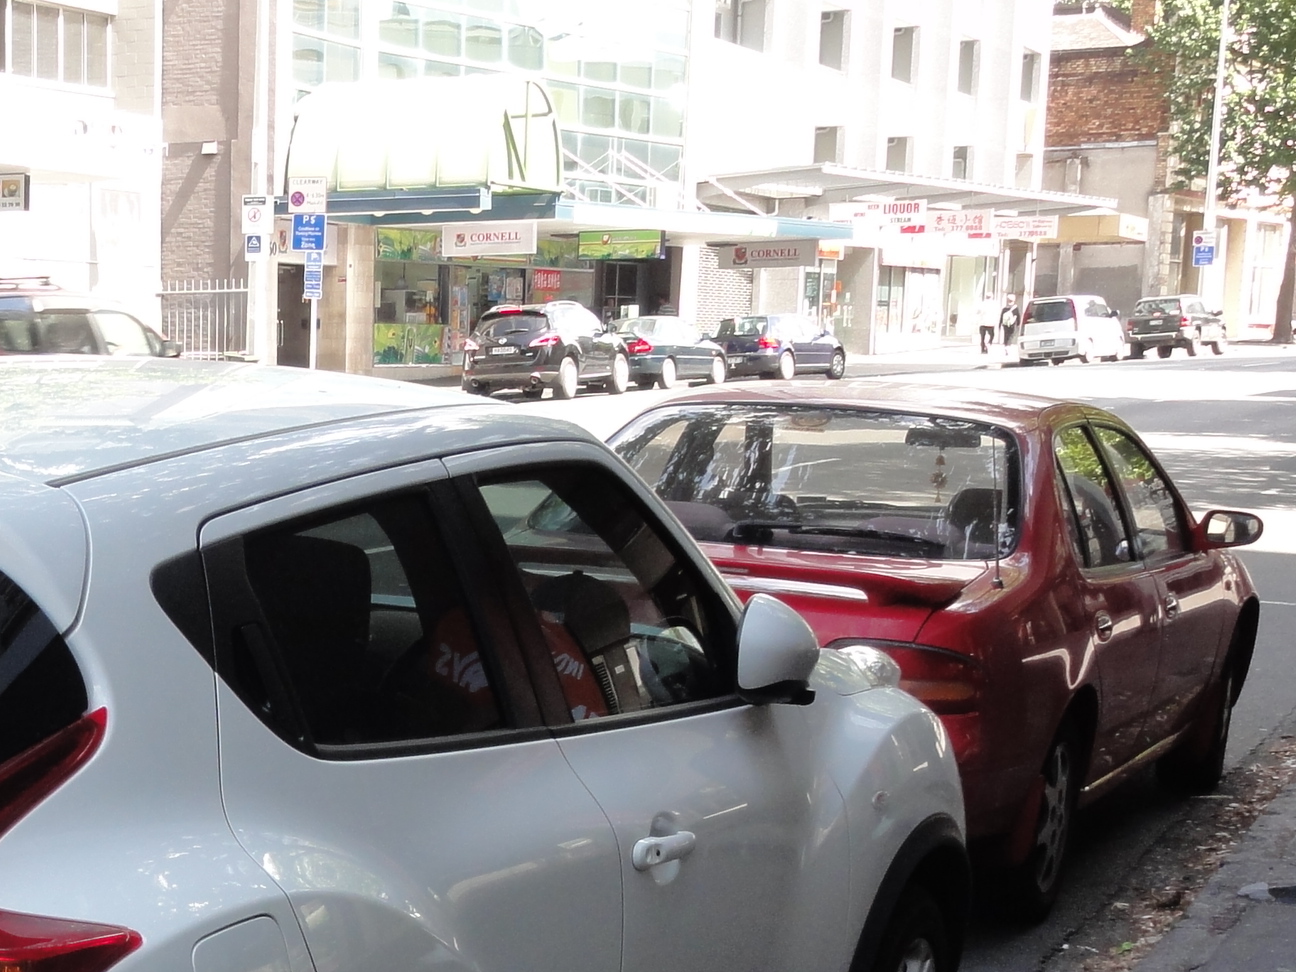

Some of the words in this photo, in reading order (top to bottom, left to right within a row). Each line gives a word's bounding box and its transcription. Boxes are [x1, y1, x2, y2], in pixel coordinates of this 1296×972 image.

[883, 202, 920, 215] LIQUOR
[470, 231, 522, 243] CORNELL
[750, 248, 801, 259] CORNELL
